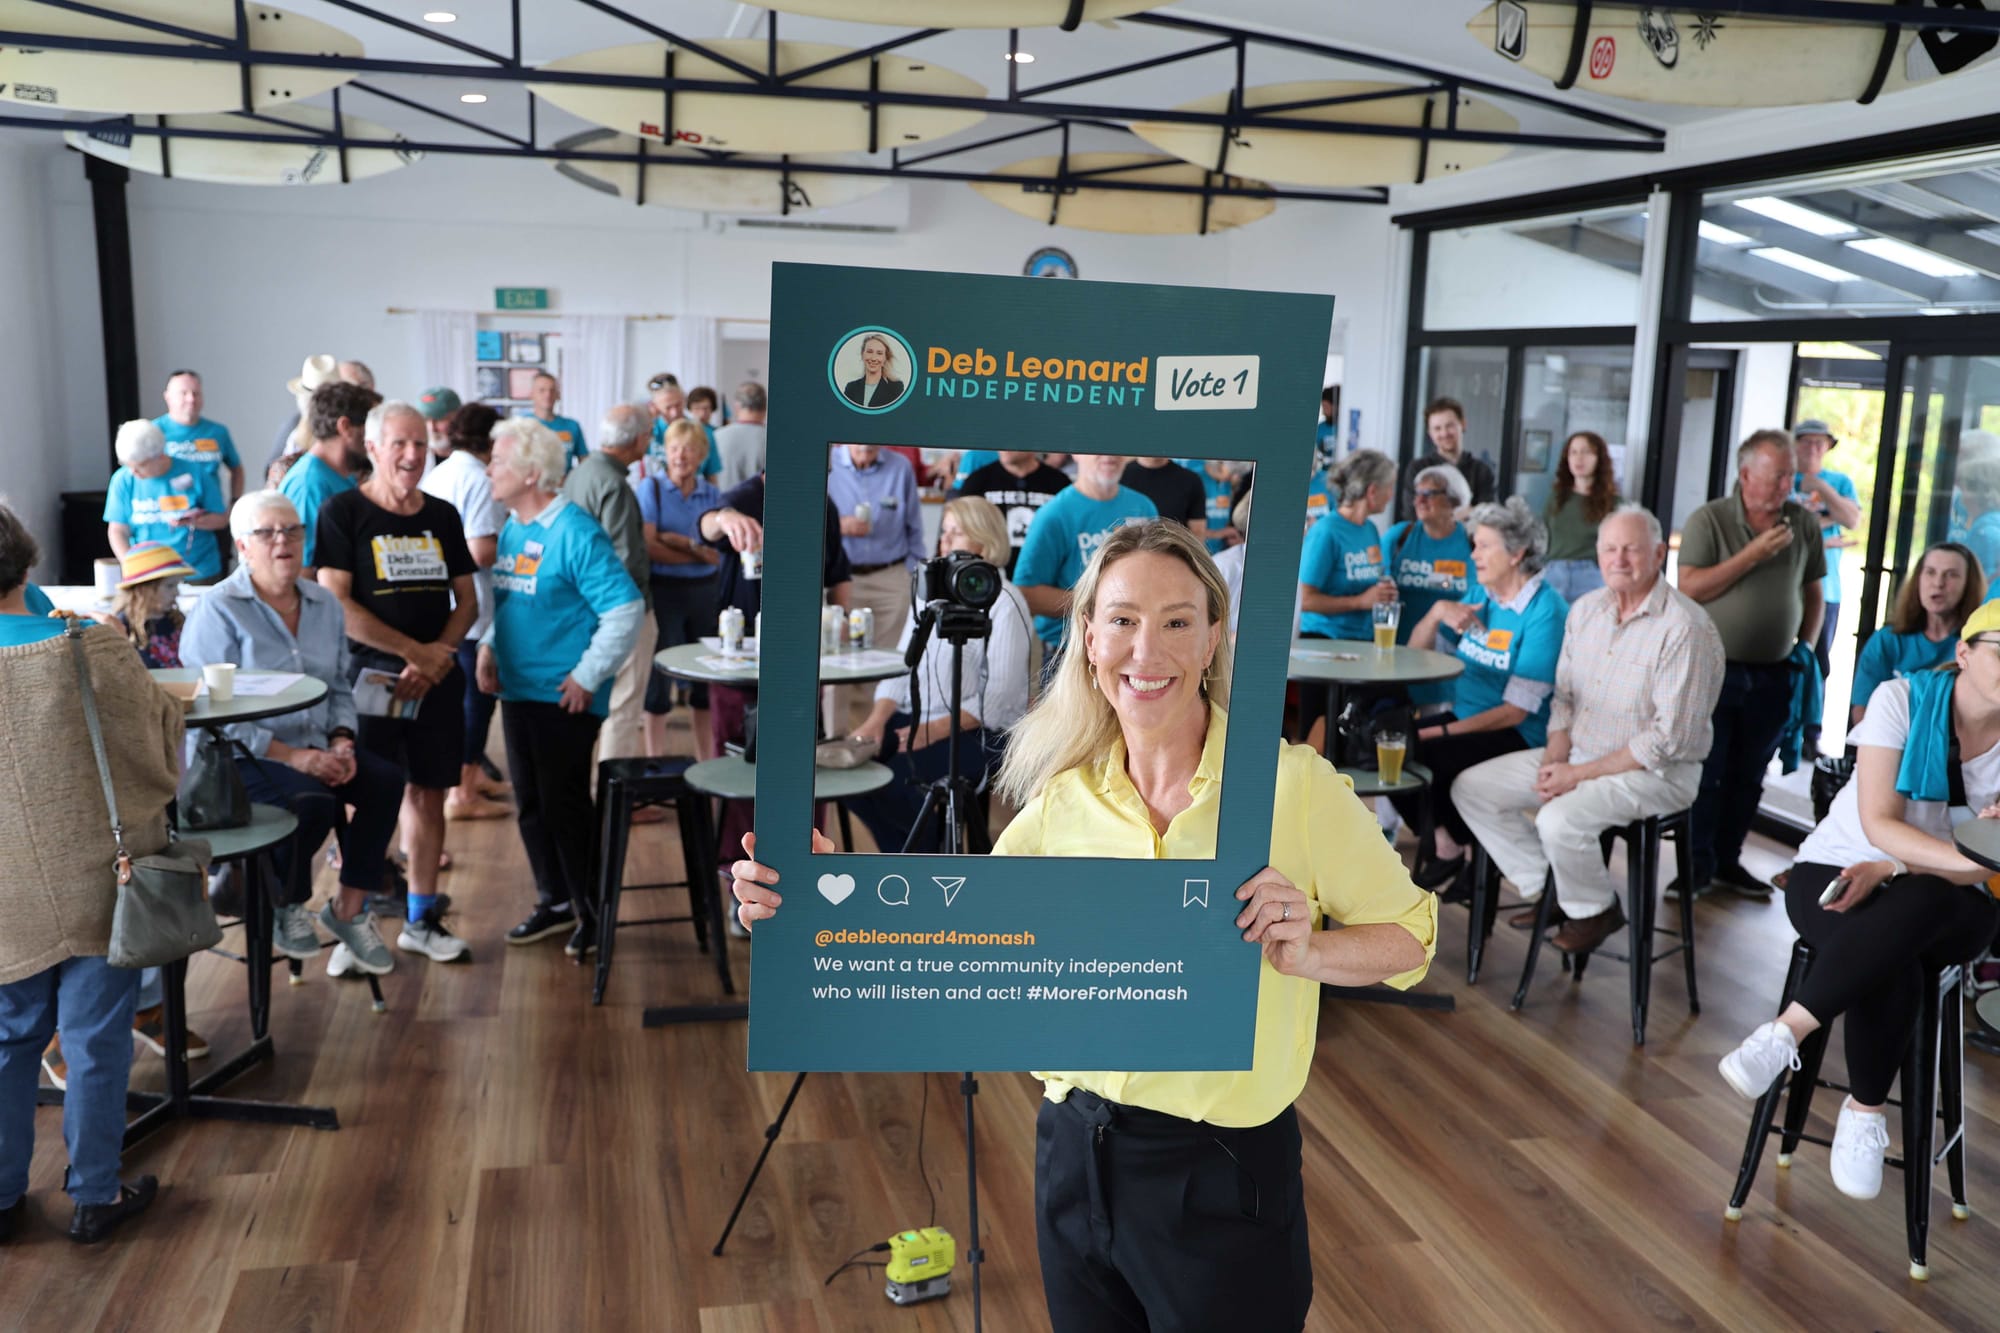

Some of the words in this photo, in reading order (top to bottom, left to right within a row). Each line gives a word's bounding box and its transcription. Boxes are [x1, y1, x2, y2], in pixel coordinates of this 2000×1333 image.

[928, 347, 997, 376] Deb
[1006, 351, 1149, 383] Leonard
[926, 377, 1145, 406] INDEPENDENT
[1172, 368, 1226, 401] Vote
[1233, 369, 1248, 395] 1
[815, 929, 1035, 947] @debleonard4monash
[813, 957, 843, 972] We
[848, 958, 895, 972] want
[900, 960, 912, 972] a
[917, 958, 953, 972] true
[958, 958, 1064, 977] community
[1069, 958, 1183, 977] independent
[812, 984, 851, 999] who
[857, 984, 886, 999] will
[891, 985, 940, 1000] listen
[945, 985, 981, 1000] and
[986, 986, 1021, 1000] act!
[1026, 986, 1188, 1000] #MoreForMonash
